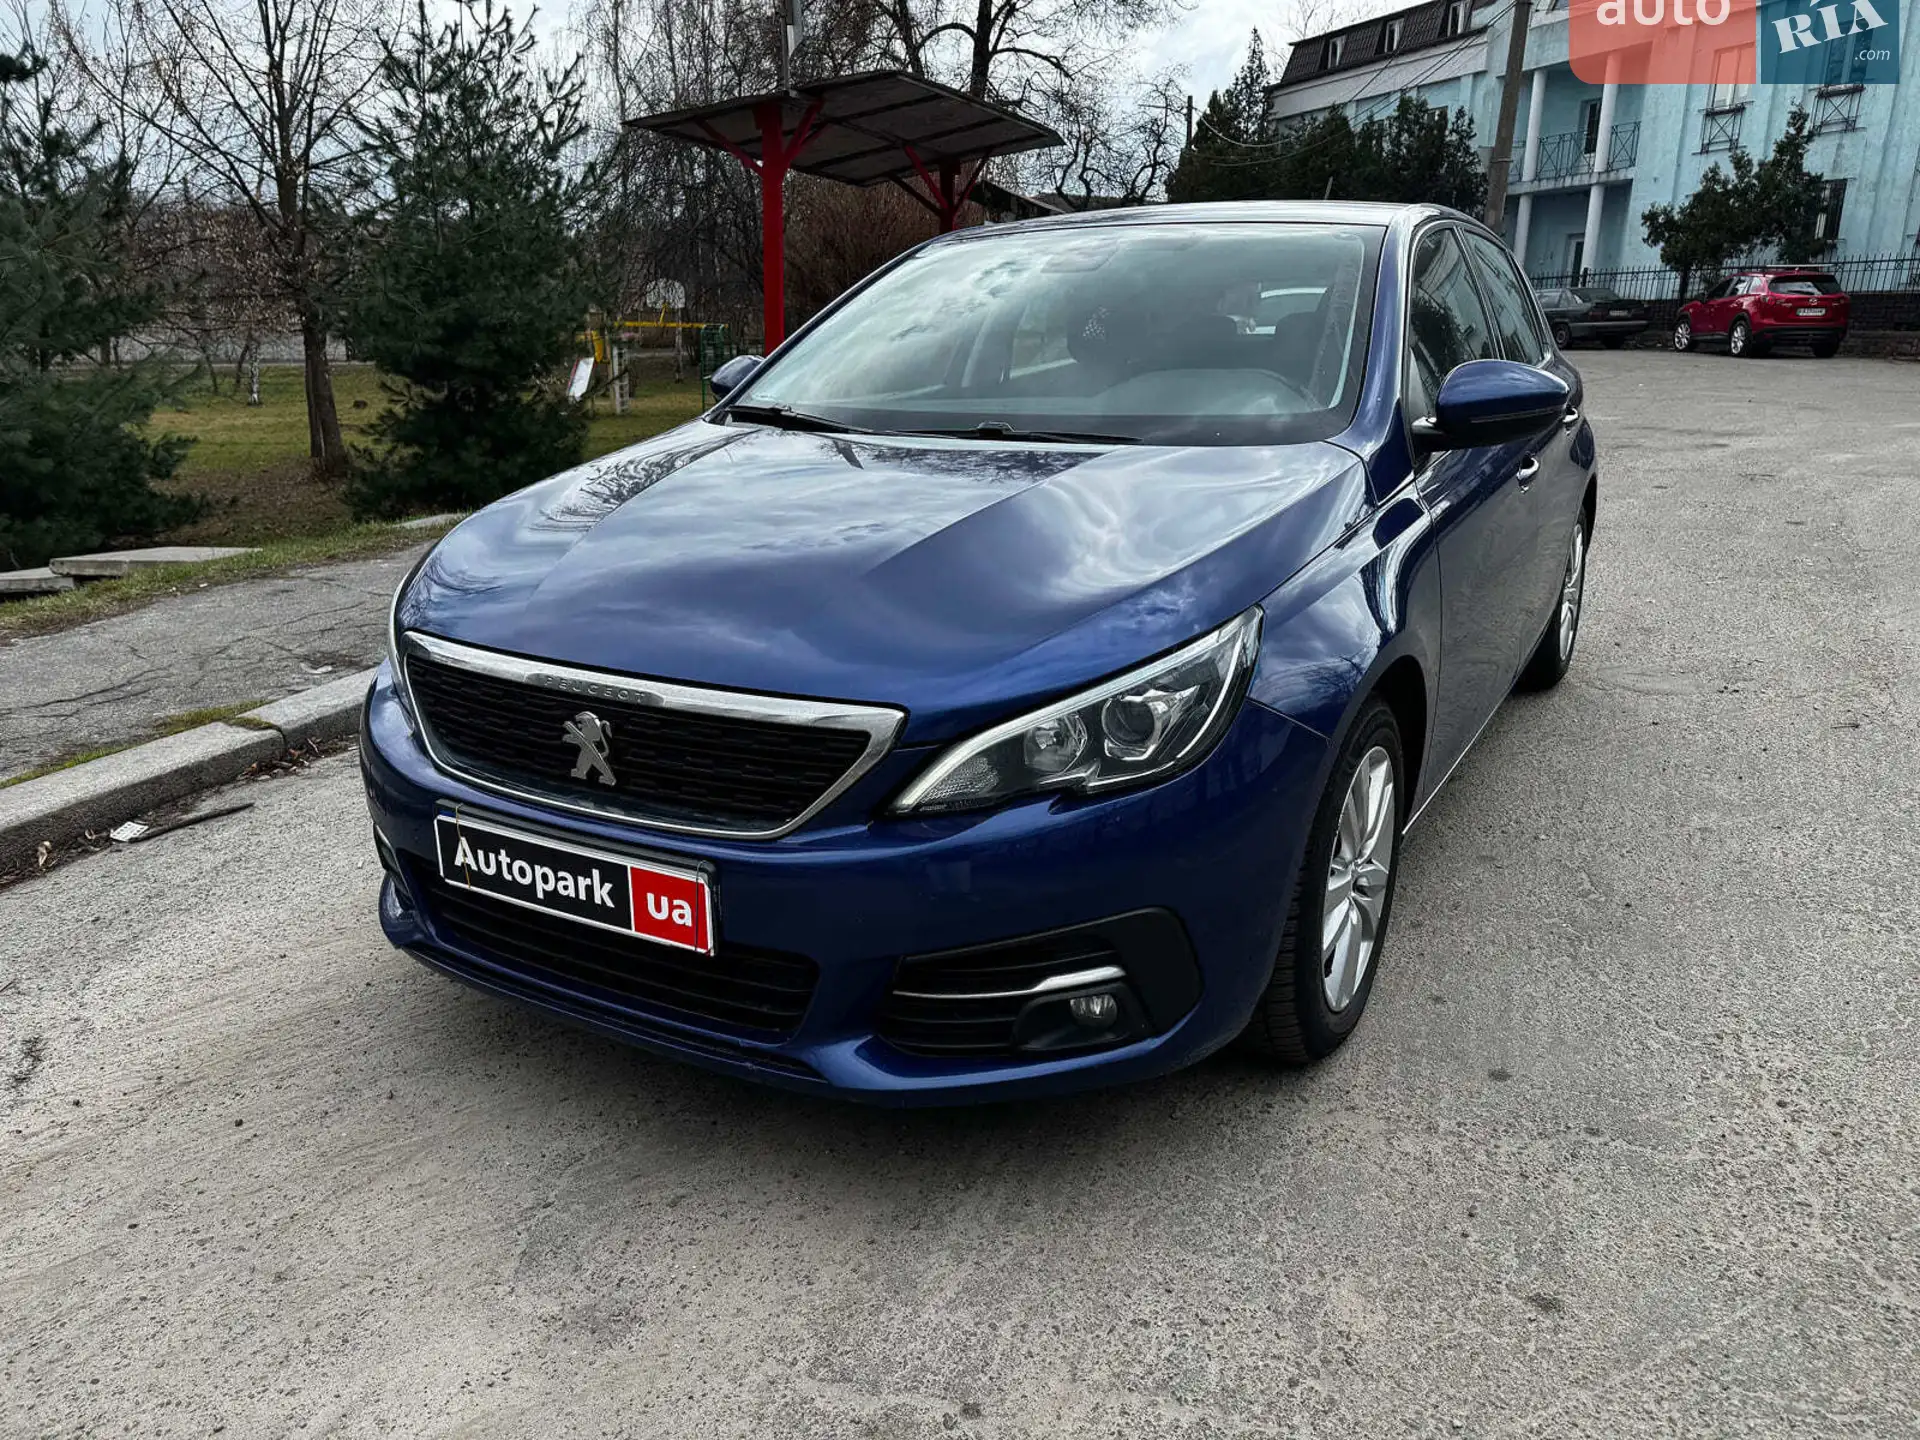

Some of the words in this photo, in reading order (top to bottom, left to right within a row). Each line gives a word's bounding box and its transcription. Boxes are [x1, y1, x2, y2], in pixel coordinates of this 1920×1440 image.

[543, 676, 646, 703] PEUGEOT
[454, 836, 615, 908] Autopark
[646, 892, 693, 927] ua
